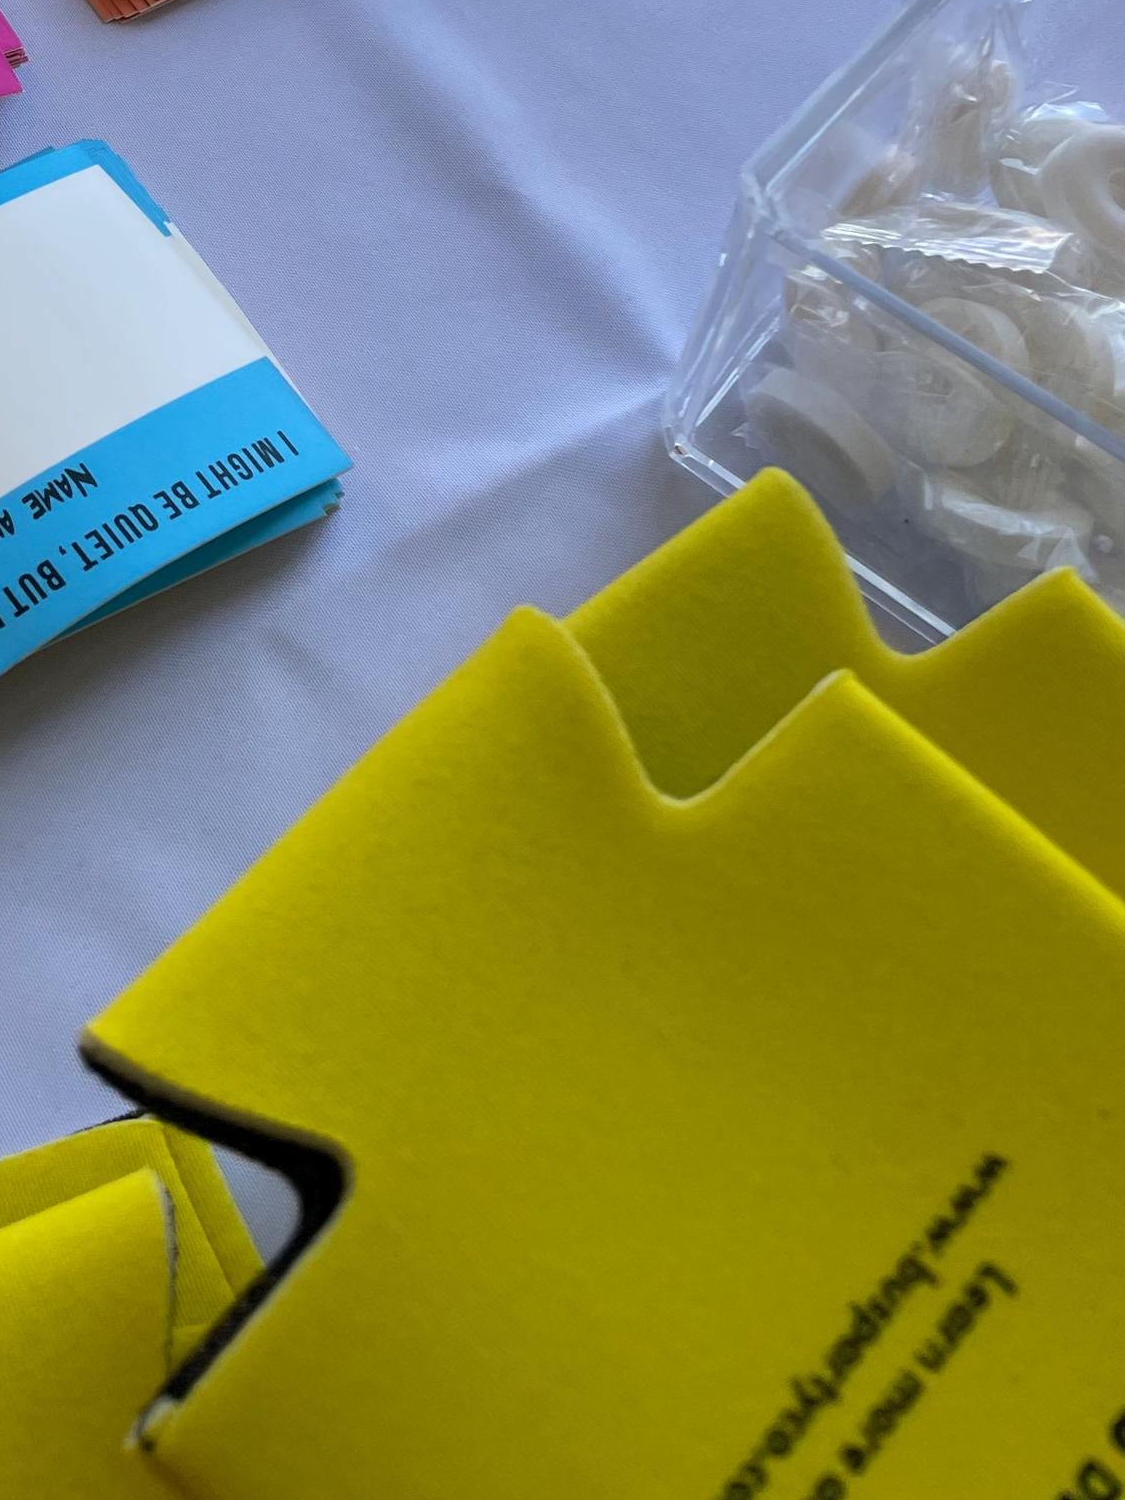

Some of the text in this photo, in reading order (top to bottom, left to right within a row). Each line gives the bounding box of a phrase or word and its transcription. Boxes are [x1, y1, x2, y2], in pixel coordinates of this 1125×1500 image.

[195, 437, 285, 500] MIGHT
[276, 430, 300, 456] I
[21, 462, 99, 520] NAME
[152, 481, 201, 521] BE
[58, 503, 160, 572] QUIET,
[2, 559, 67, 618] BUT
[912, 1260, 1020, 1374] Learn
